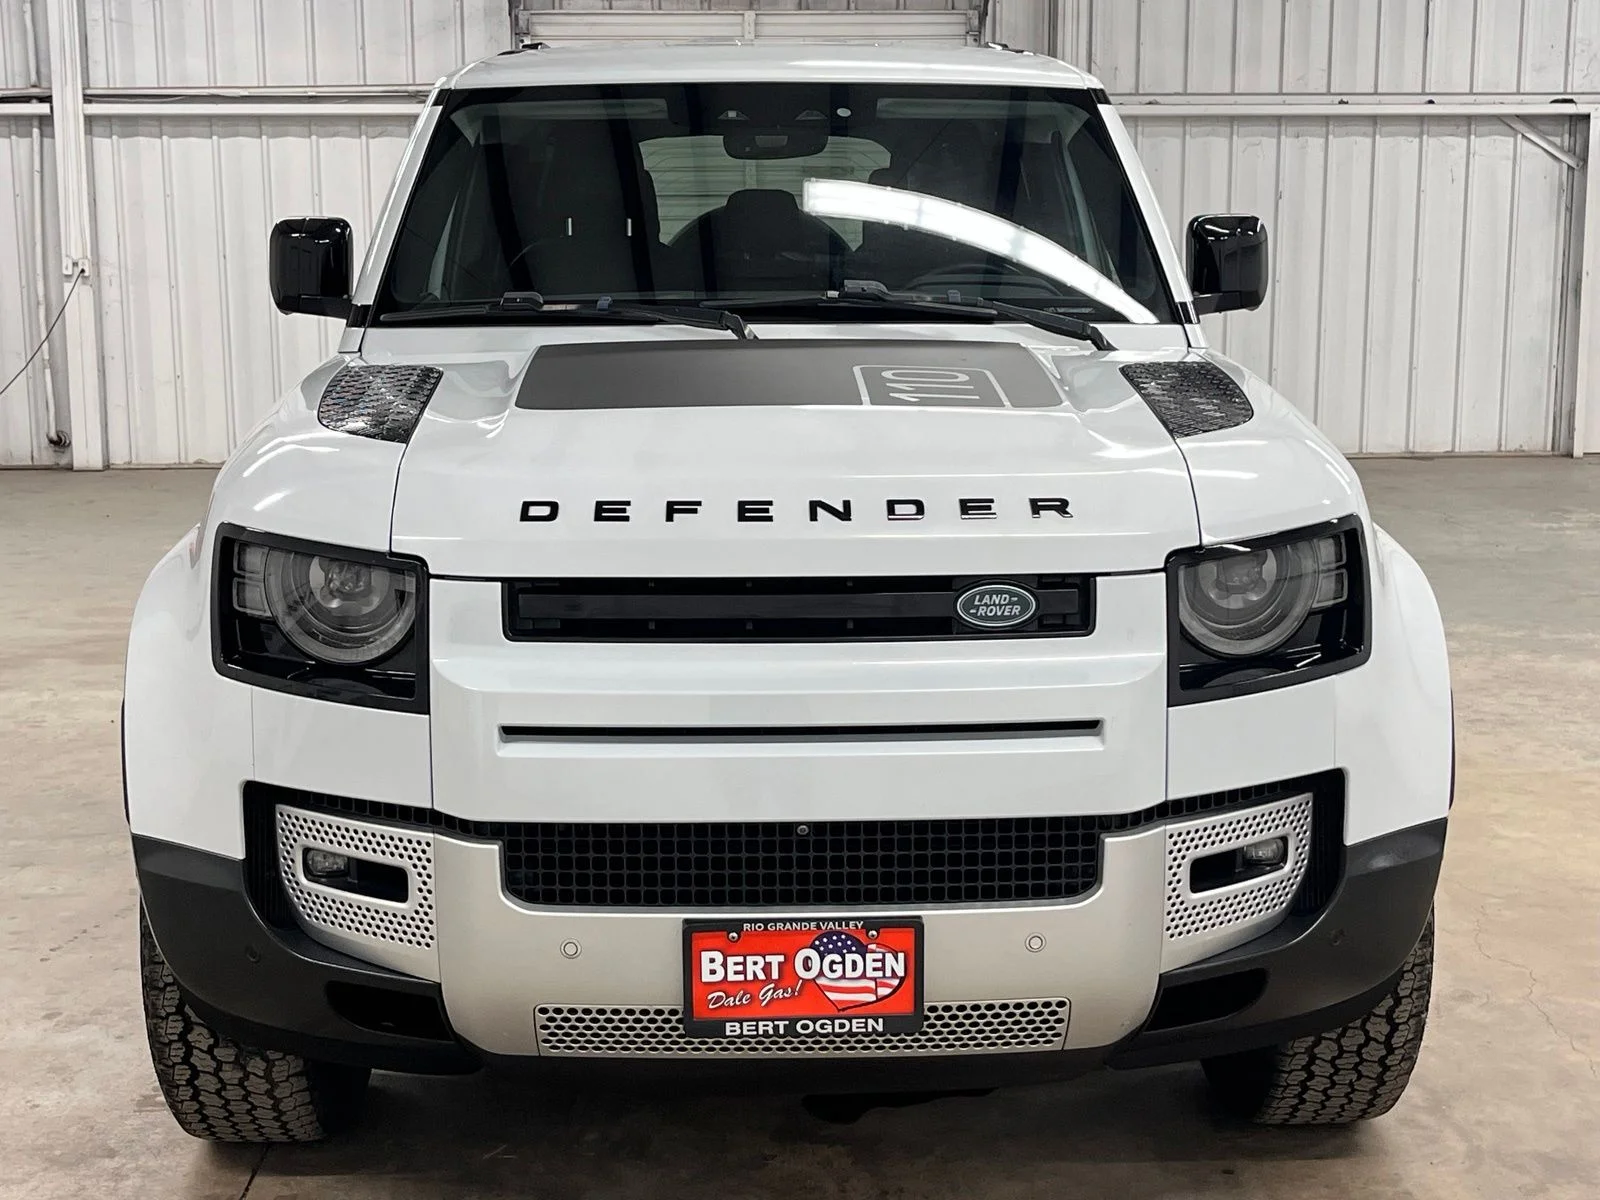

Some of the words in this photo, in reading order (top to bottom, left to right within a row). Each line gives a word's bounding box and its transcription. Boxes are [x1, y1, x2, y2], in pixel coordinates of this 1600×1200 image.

[881, 369, 980, 402] 110
[519, 497, 1075, 523] DEFENDER
[743, 922, 765, 932] RIO
[767, 922, 818, 931] GRANDE
[820, 921, 864, 930] VALLEY
[700, 950, 785, 983] BERT
[794, 947, 905, 980] OGDEN
[707, 991, 751, 1009] Dale
[758, 979, 803, 1007] Gas!
[725, 1021, 789, 1036] BERT
[796, 1018, 884, 1034] OGDEN
